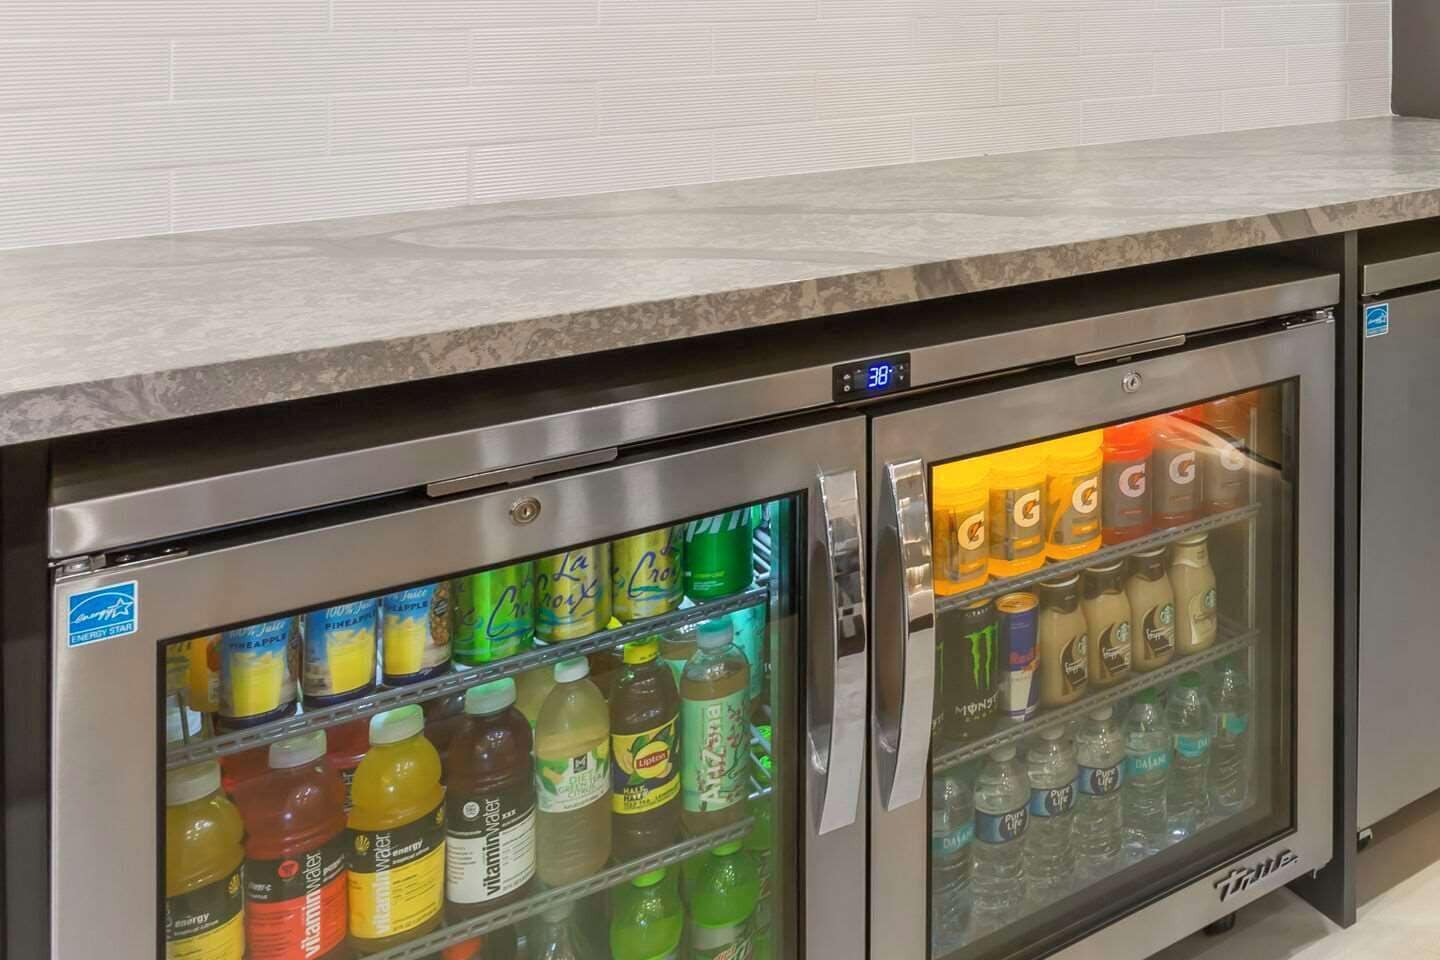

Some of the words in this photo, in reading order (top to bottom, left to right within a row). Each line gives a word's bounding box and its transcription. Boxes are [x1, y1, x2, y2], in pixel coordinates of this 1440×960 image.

[868, 366, 888, 387] 38
[1169, 451, 1196, 484] G
[1119, 463, 1146, 498] G
[1072, 476, 1097, 513] G
[1014, 490, 1040, 527] G
[958, 511, 984, 550] G
[553, 551, 588, 582] La
[257, 622, 285, 637] Juice
[325, 611, 376, 630] PINEAPPLE
[72, 630, 106, 643] ENERGY
[109, 623, 132, 635] STAR
[229, 633, 287, 649] PINEAPPLE
[638, 751, 667, 768] Lipton
[1095, 767, 1117, 779] Pure
[1097, 776, 1113, 786] Life
[624, 794, 644, 802] HALF
[1050, 788, 1072, 801] Pure
[1052, 797, 1067, 809] Life
[502, 809, 516, 819] xxx
[1004, 810, 1024, 823] Pure
[1007, 820, 1023, 835] Life
[393, 839, 423, 857] energy
[483, 799, 500, 896] vitaminwater
[372, 834, 392, 934] vitaminwater
[301, 851, 321, 959] vitaminwater
[175, 913, 210, 928] energy
